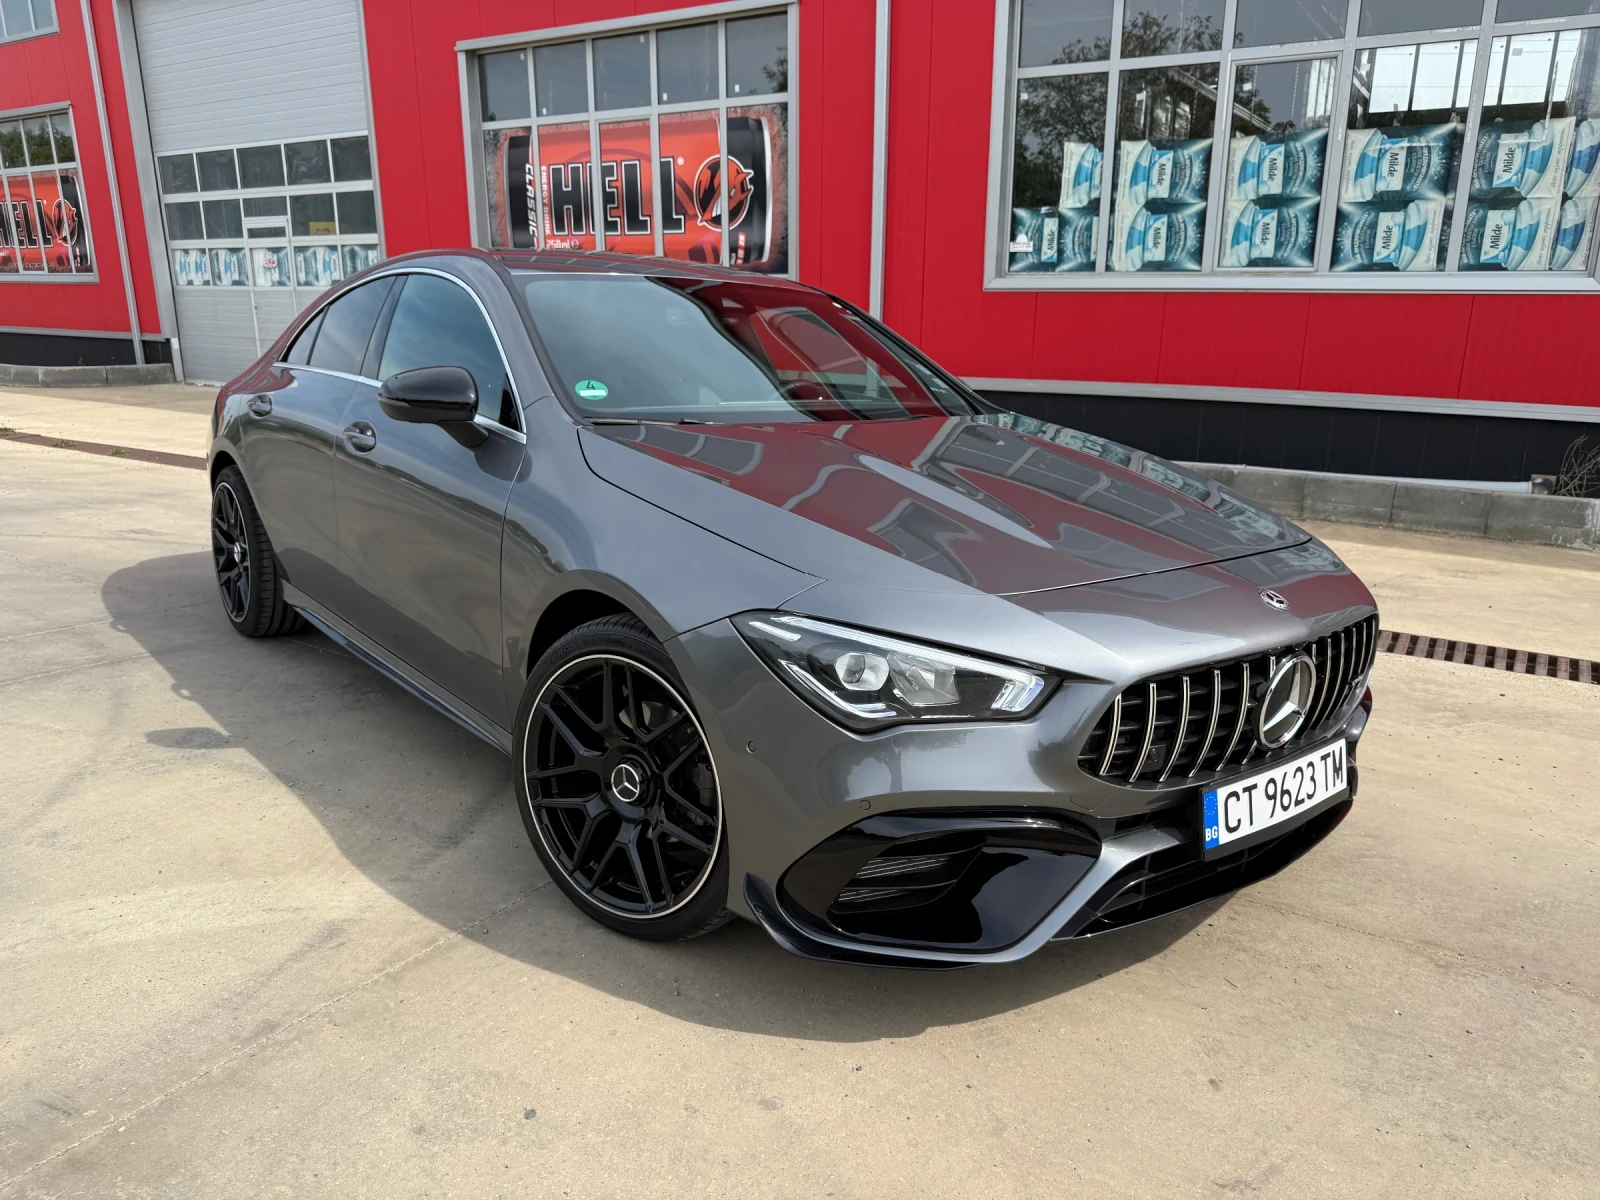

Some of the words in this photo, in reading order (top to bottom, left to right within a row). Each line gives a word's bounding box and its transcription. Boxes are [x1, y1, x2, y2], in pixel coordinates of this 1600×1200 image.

[1267, 157, 1278, 182] Milde
[1387, 152, 1399, 178] Milde
[1502, 147, 1516, 174] Milde
[541, 165, 549, 204] ENERGY
[1156, 162, 1168, 187] Milde
[525, 163, 538, 238] CLASSIC
[549, 156, 685, 236] HELL
[544, 206, 552, 236] DRINK
[1260, 221, 1271, 246] Milde
[1152, 226, 1162, 250] Milde
[1381, 225, 1394, 250] Milde
[1489, 223, 1503, 250] Milde
[586, 380, 596, 390] 4
[1224, 782, 1258, 834] CT
[1264, 761, 1317, 819] 9623
[1320, 745, 1344, 792] TM
[1205, 825, 1219, 842] BG
